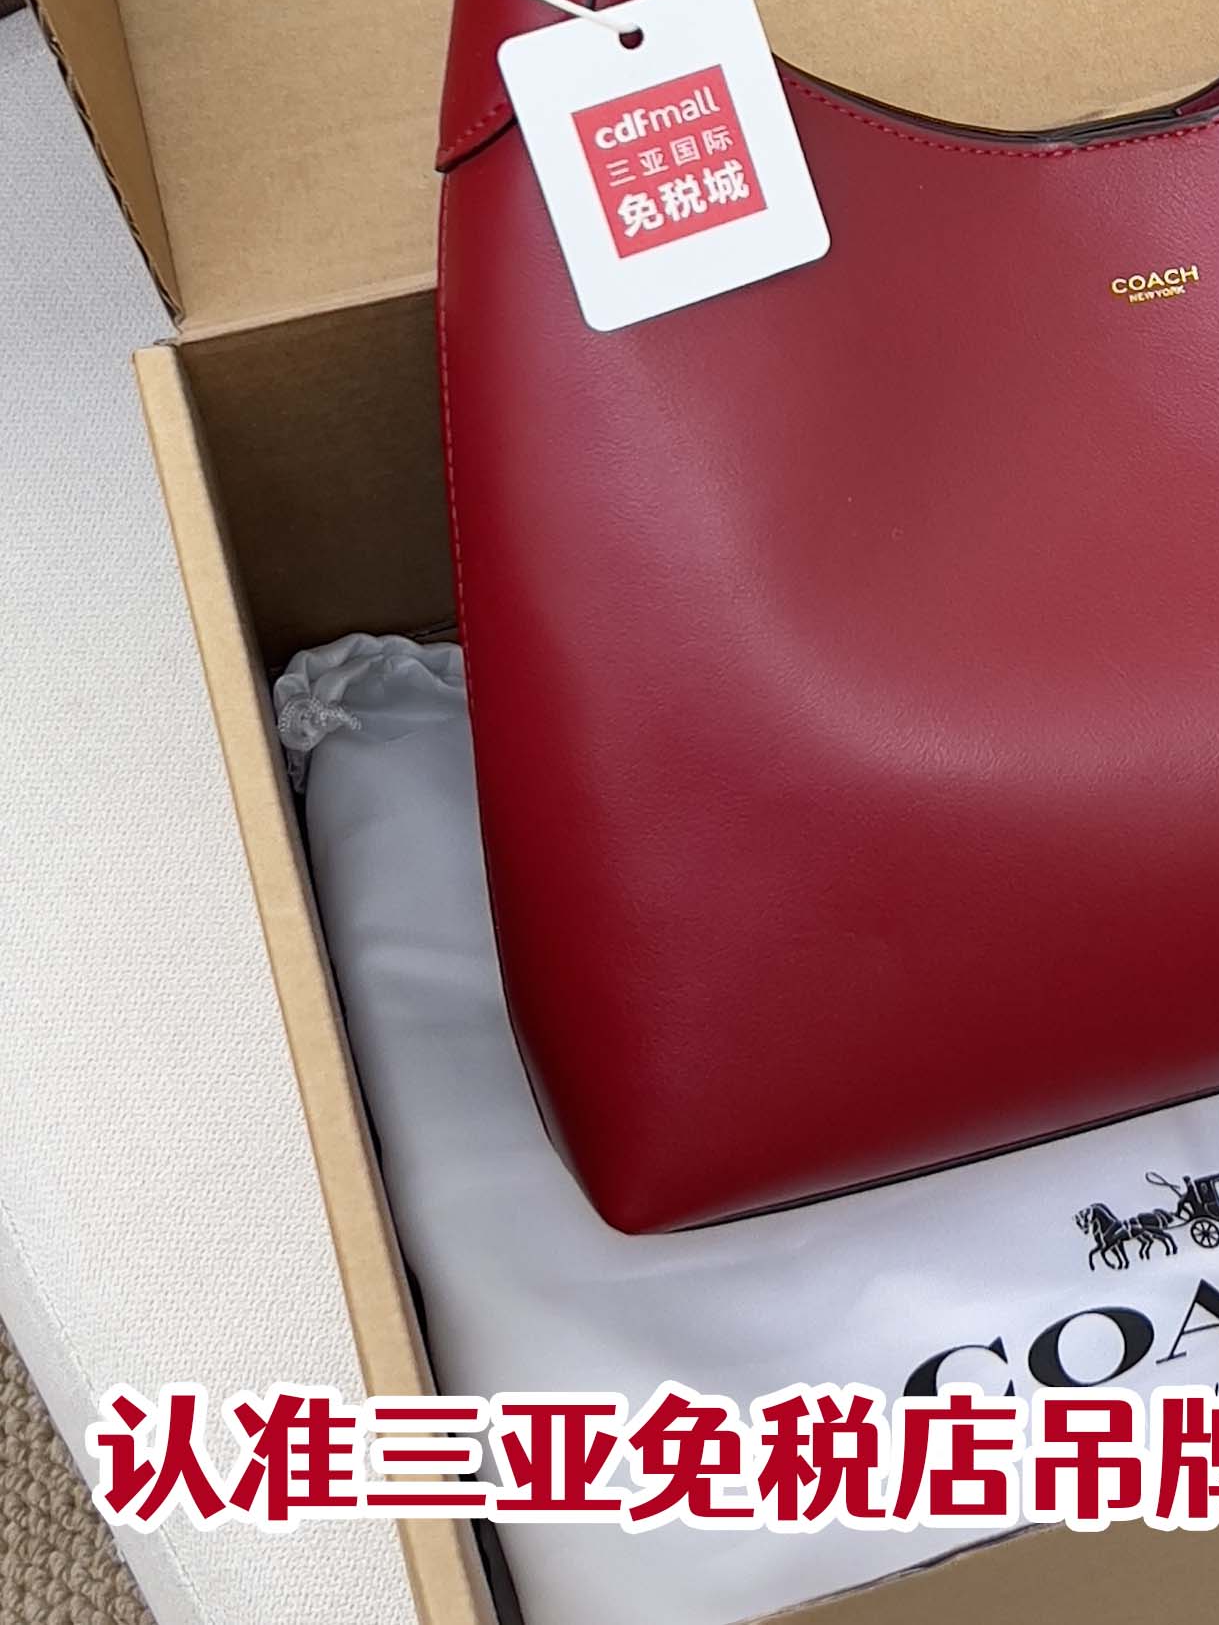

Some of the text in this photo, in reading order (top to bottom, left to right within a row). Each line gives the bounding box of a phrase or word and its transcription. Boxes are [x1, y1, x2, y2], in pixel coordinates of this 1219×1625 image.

[605, 124, 734, 188] 三亚国际
[616, 159, 751, 238] 免税城
[1110, 264, 1200, 295] COACH
